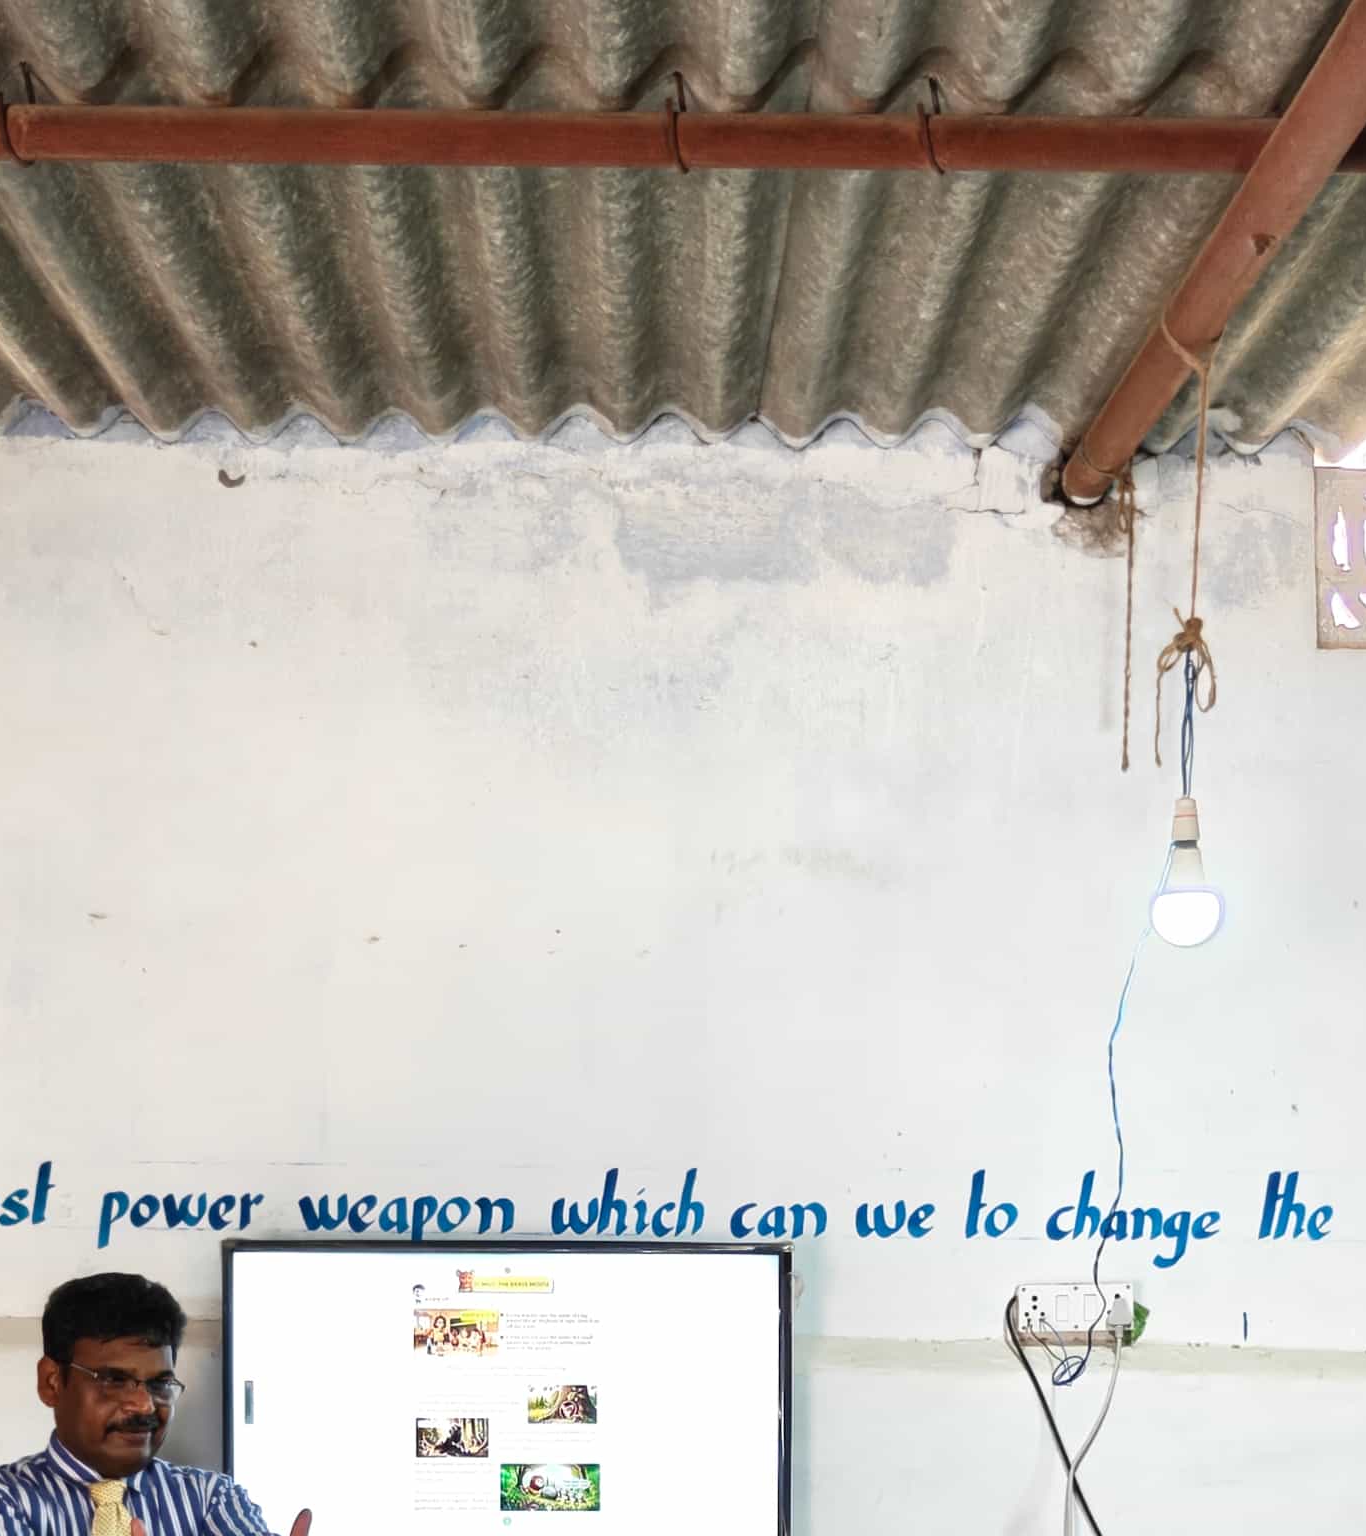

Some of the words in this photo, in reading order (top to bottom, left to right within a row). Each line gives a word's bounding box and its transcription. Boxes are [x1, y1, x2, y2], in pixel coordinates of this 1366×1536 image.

[98, 1192, 263, 1248] power
[299, 1195, 514, 1238] weapon
[551, 1168, 704, 1238] which
[731, 1202, 827, 1239] can
[856, 1200, 935, 1238] we
[965, 1170, 1018, 1238] to
[1046, 1170, 1220, 1268] change
[1259, 1171, 1333, 1240] the
